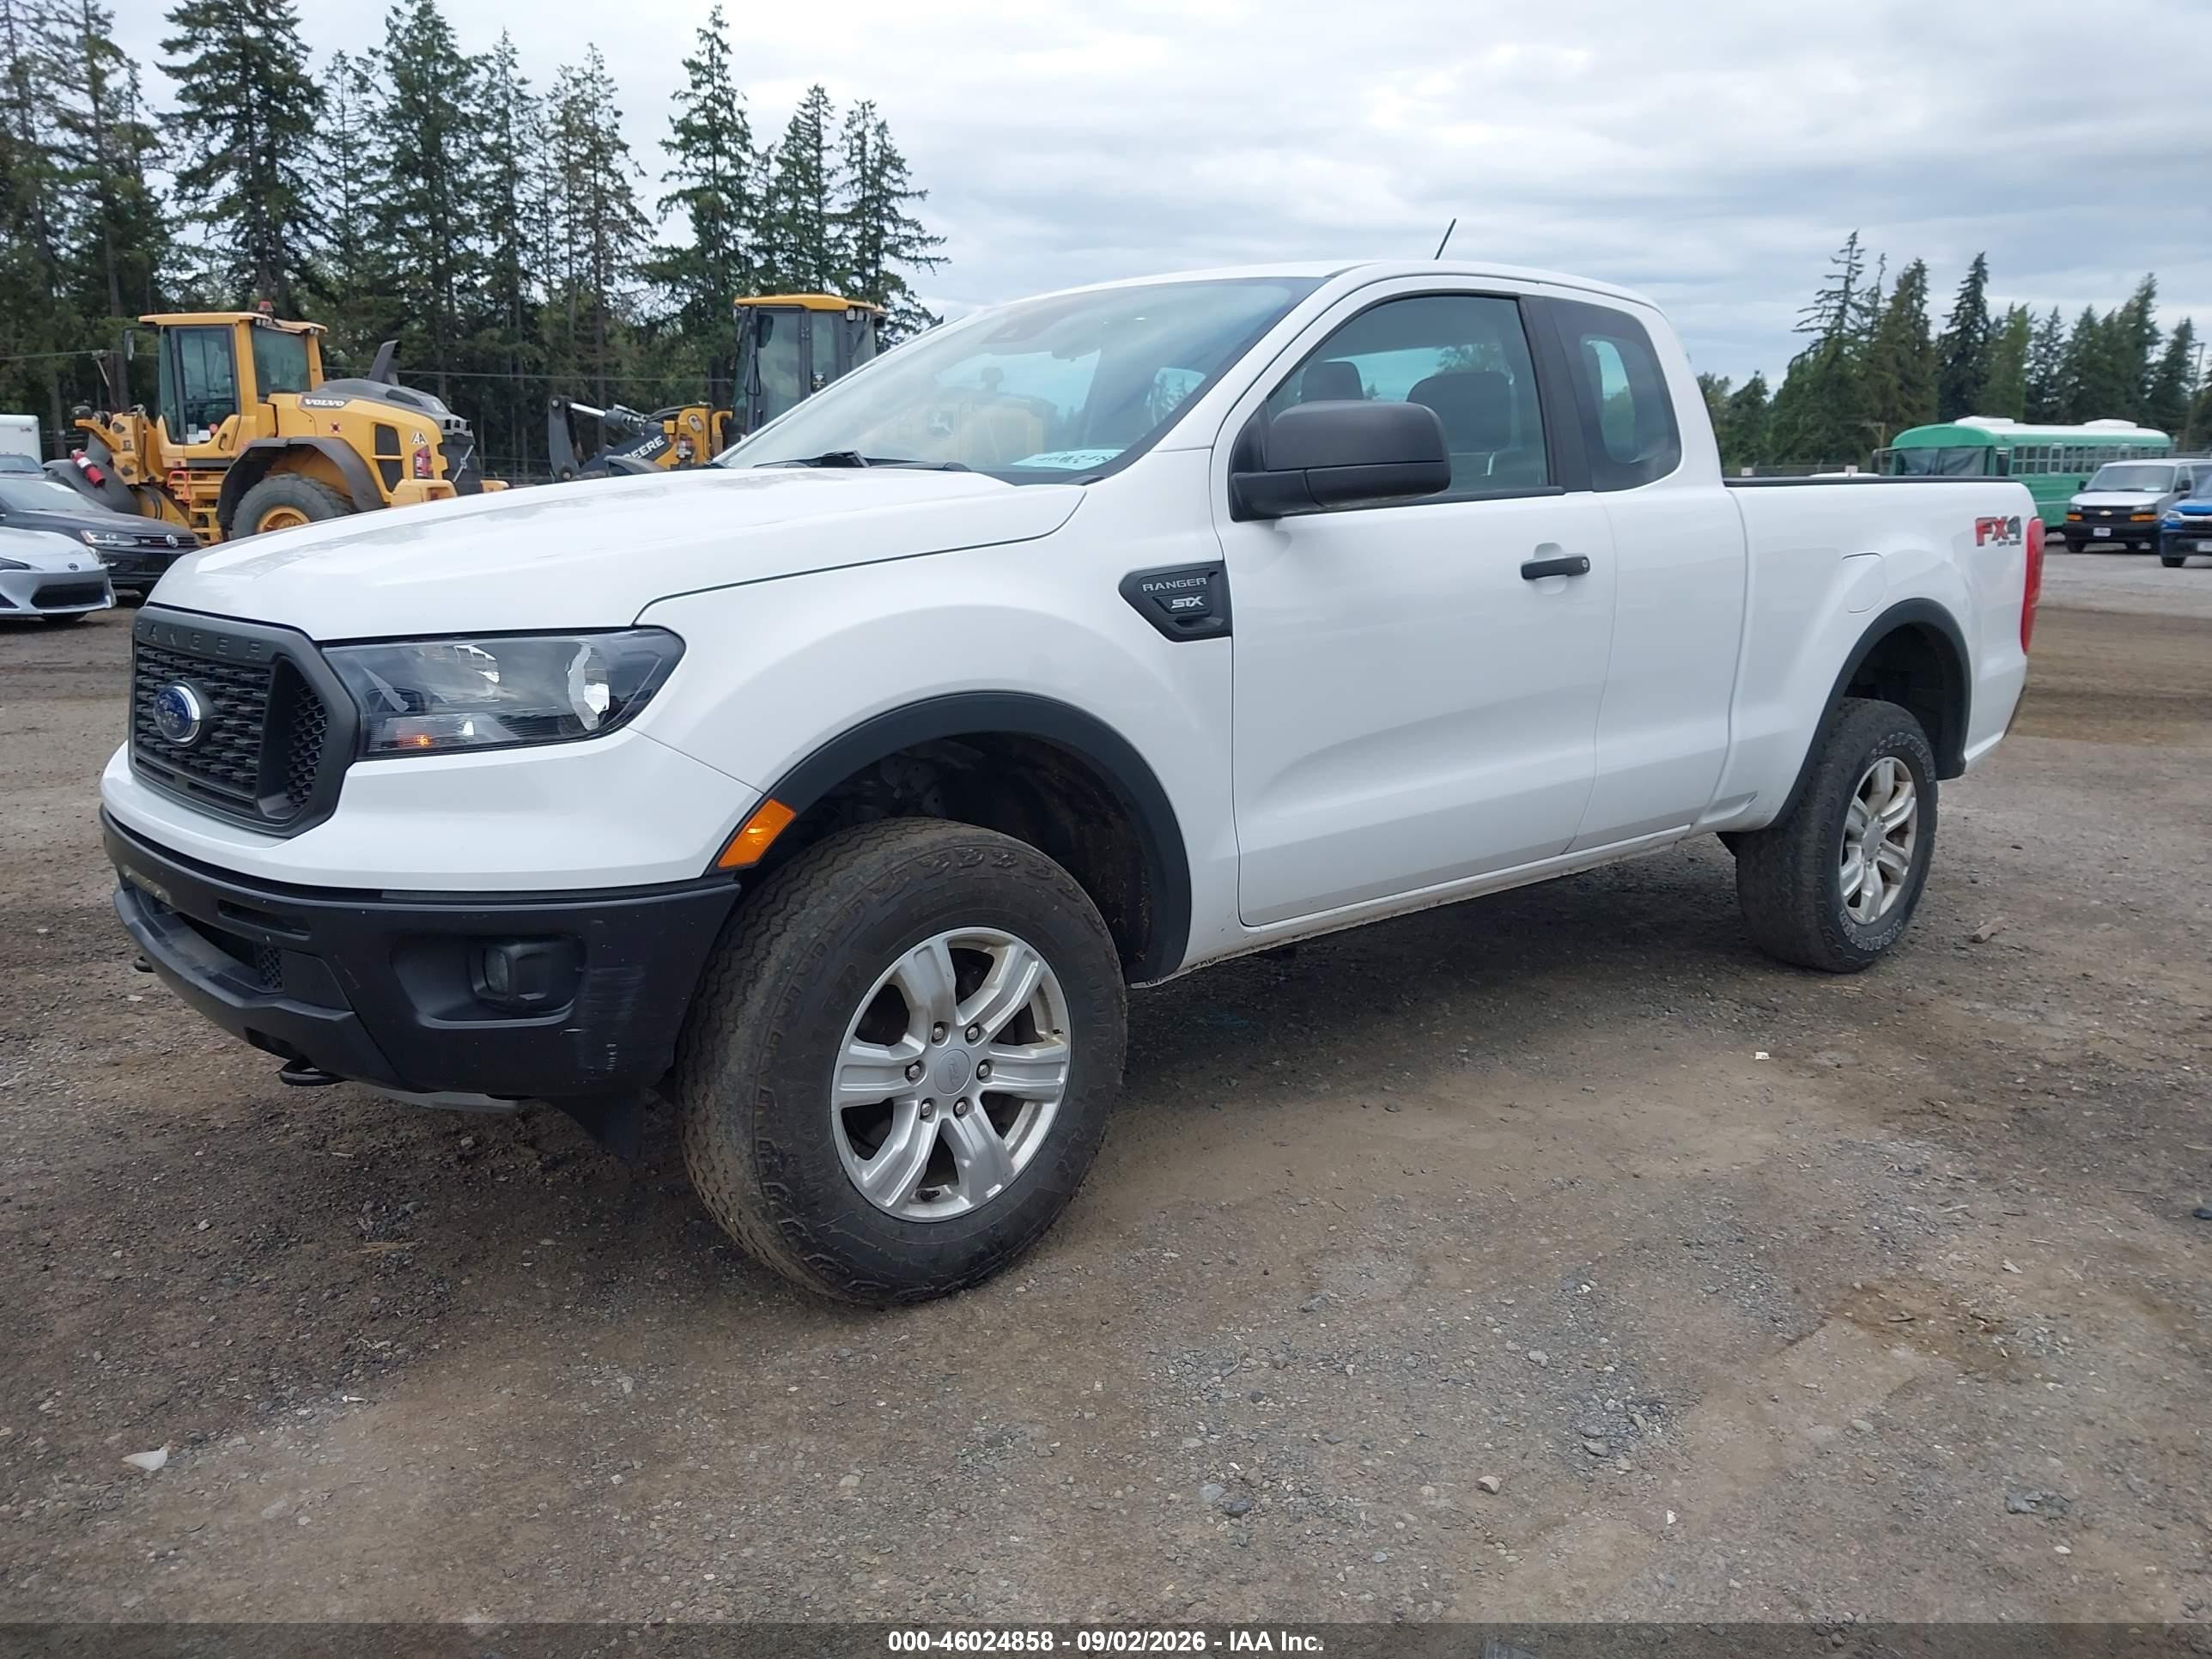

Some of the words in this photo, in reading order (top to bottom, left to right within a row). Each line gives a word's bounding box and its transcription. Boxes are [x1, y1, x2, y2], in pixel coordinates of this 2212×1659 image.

[304, 398, 345, 407] VOLVO
[1975, 516, 2021, 546] FX4
[1142, 577, 1207, 592] RANGER
[1170, 596, 1205, 610] STX
